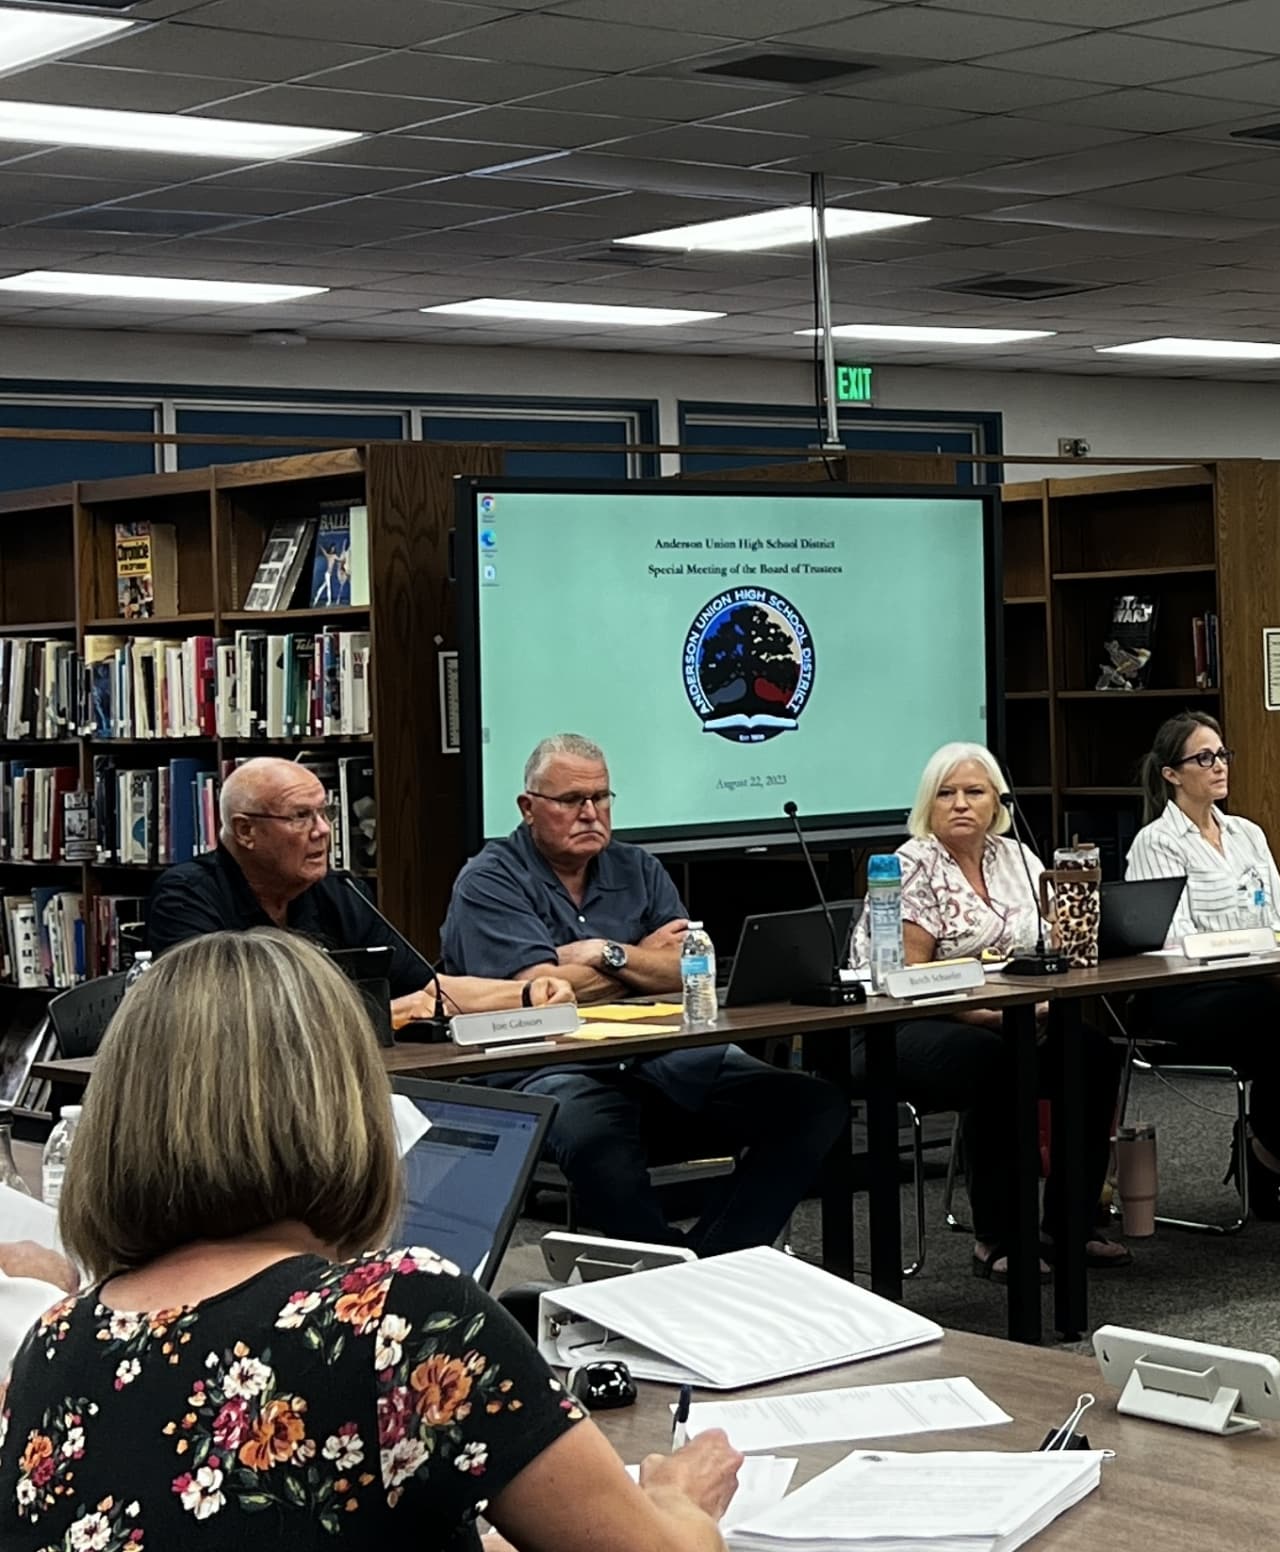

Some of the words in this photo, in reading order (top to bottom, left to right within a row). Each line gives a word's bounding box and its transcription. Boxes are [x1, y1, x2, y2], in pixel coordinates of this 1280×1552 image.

[837, 366, 873, 400] EXIT
[655, 539, 703, 549] Anderson
[705, 539, 736, 549] Union
[739, 538, 764, 551] High
[766, 538, 798, 549] School
[800, 538, 835, 549] District
[648, 564, 684, 578] Special
[686, 564, 727, 577] Meeting
[729, 563, 740, 574] of
[742, 564, 757, 574] the
[759, 563, 789, 574] Board
[790, 563, 802, 574] of
[802, 564, 843, 574] Trustees
[734, 589, 766, 601] HIGH
[695, 593, 732, 629] UNION
[769, 595, 805, 645] SCHOOL
[1112, 604, 1153, 623] WARS
[685, 631, 711, 714] ANDERSON
[788, 648, 812, 714] DISTRICT
[716, 778, 748, 791] August
[750, 775, 764, 788] 22,
[765, 774, 788, 786] 2023
[491, 1022, 508, 1032] Joe
[509, 1018, 543, 1029] Gibson
